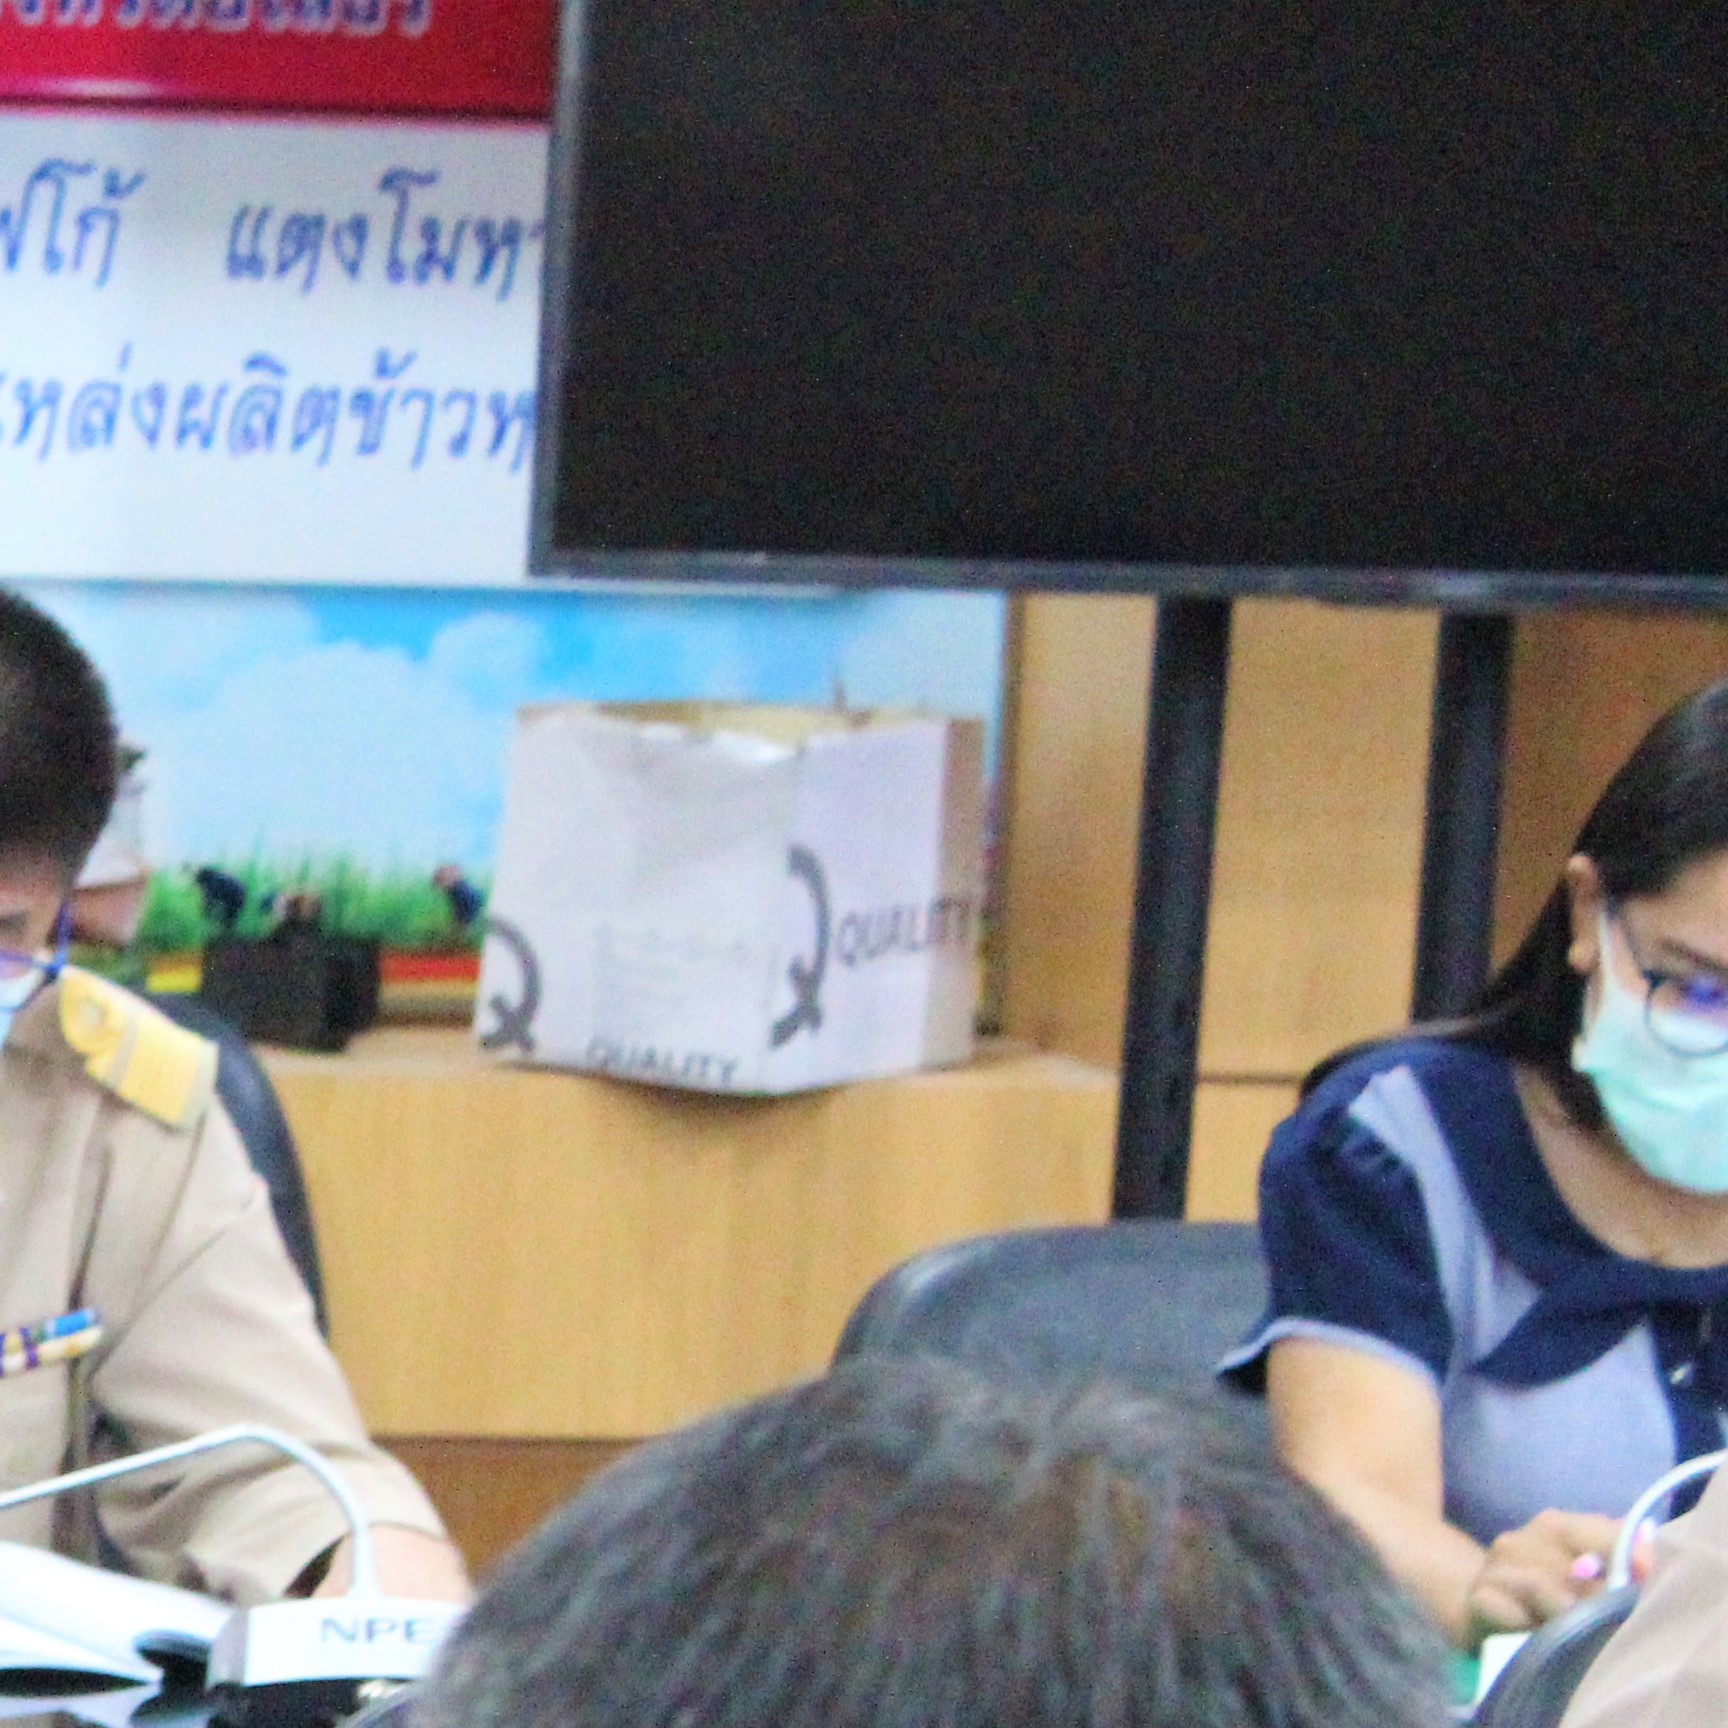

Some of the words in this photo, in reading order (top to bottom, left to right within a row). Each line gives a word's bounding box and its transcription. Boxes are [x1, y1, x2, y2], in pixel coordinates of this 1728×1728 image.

[224, 165, 545, 301] แตงโมห
[320, 1616, 438, 1645] NPE
